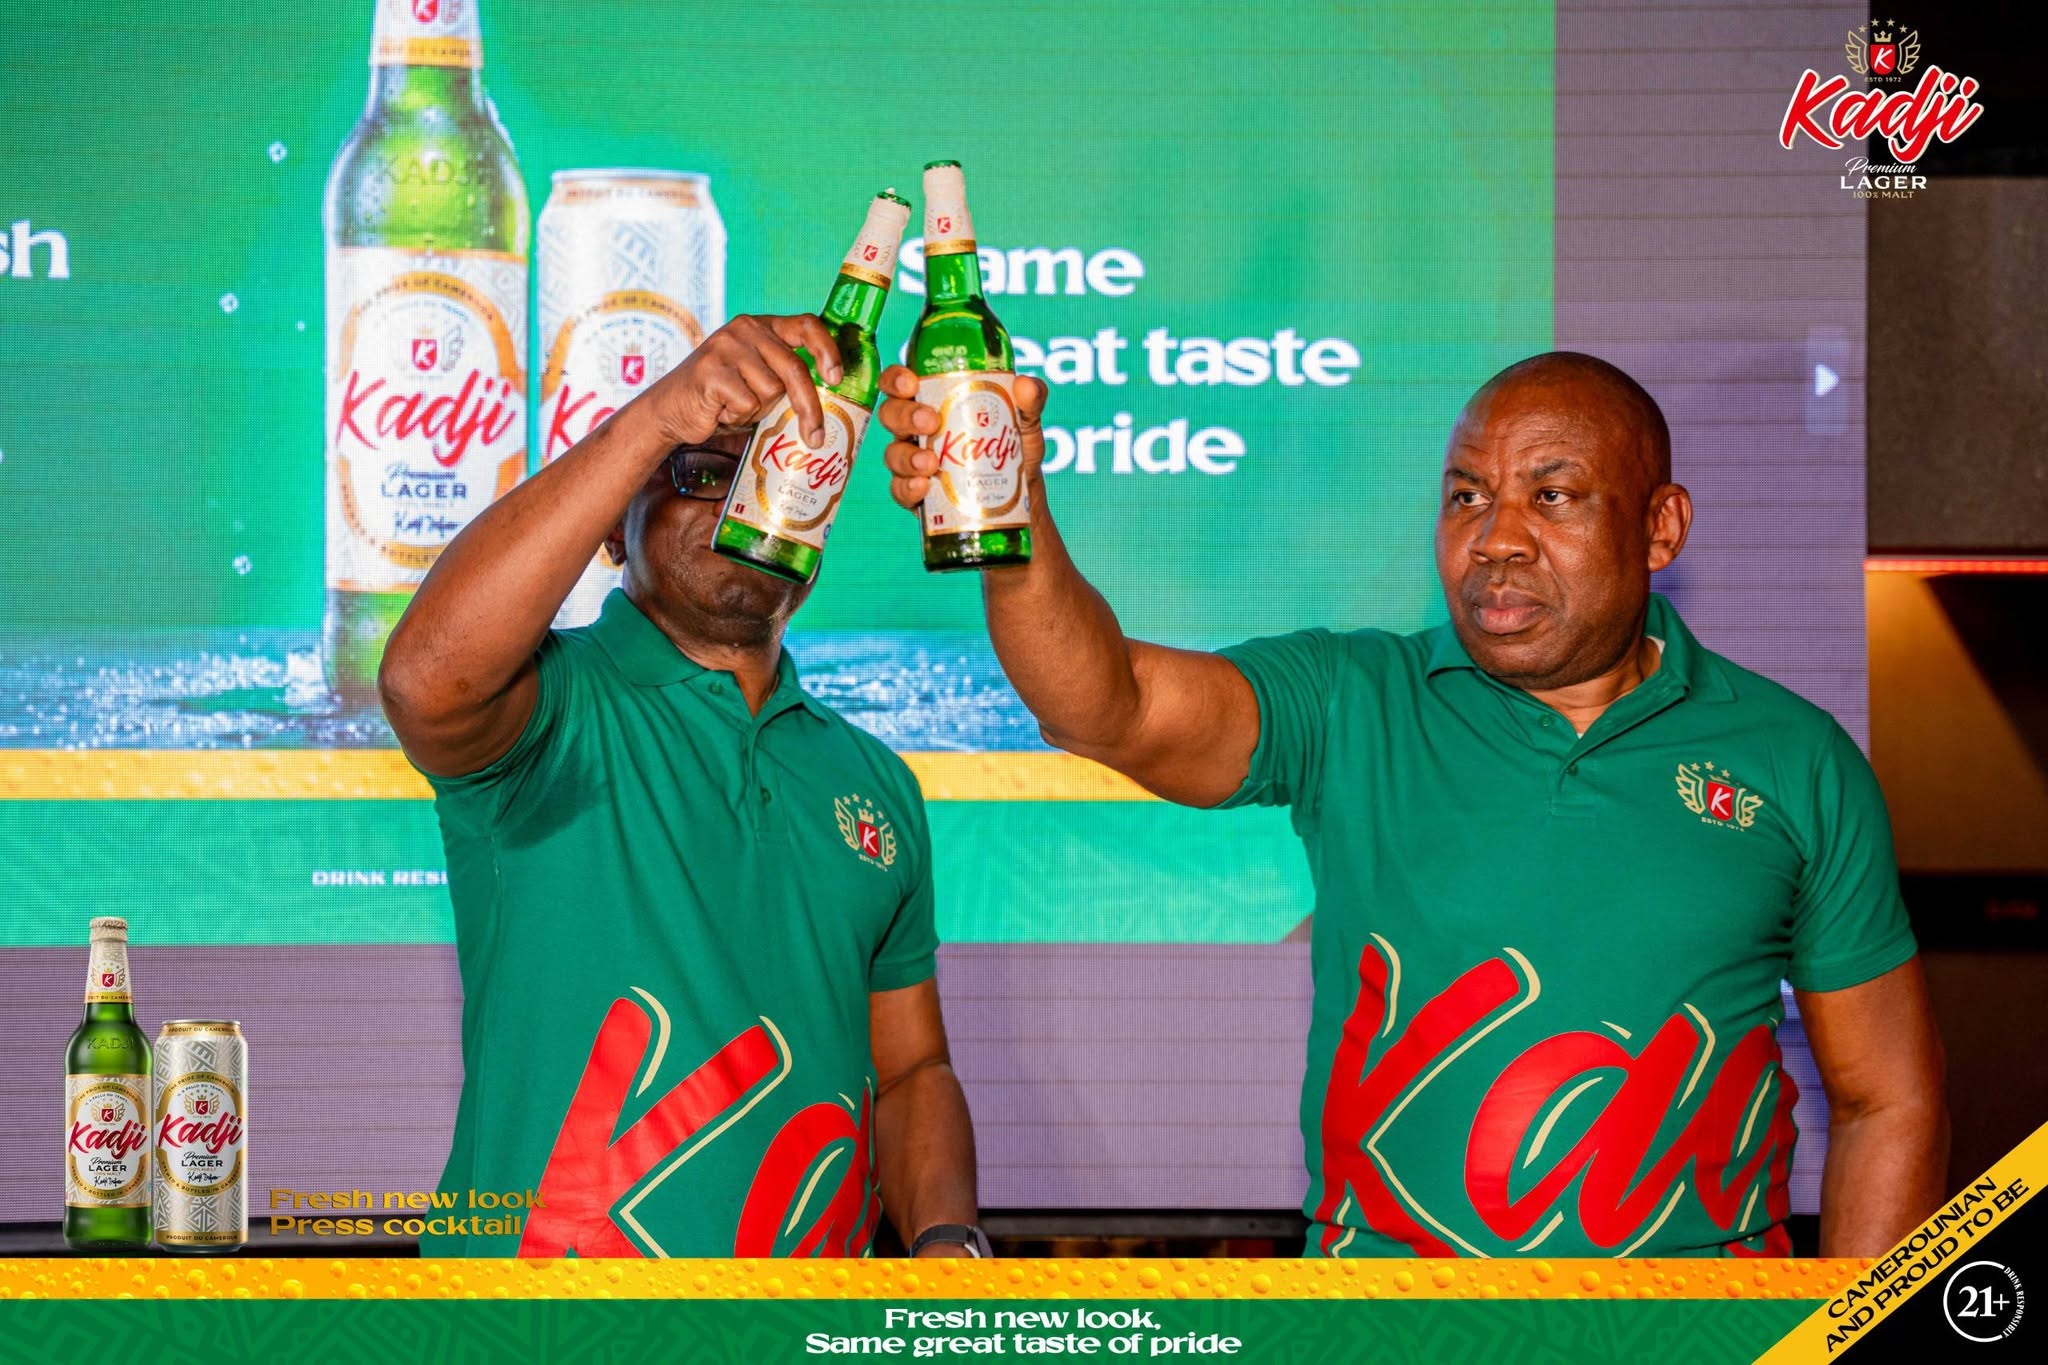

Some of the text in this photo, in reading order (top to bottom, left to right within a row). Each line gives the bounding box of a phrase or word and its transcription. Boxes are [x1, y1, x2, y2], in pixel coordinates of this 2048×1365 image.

[1143, 328, 1361, 386] taste
[336, 369, 516, 468] Kadji
[762, 433, 848, 490] Kadji
[938, 425, 1020, 471] Kadji
[382, 483, 467, 499] LAGER
[1710, 787, 1731, 817] K
[312, 870, 385, 886] DRINK
